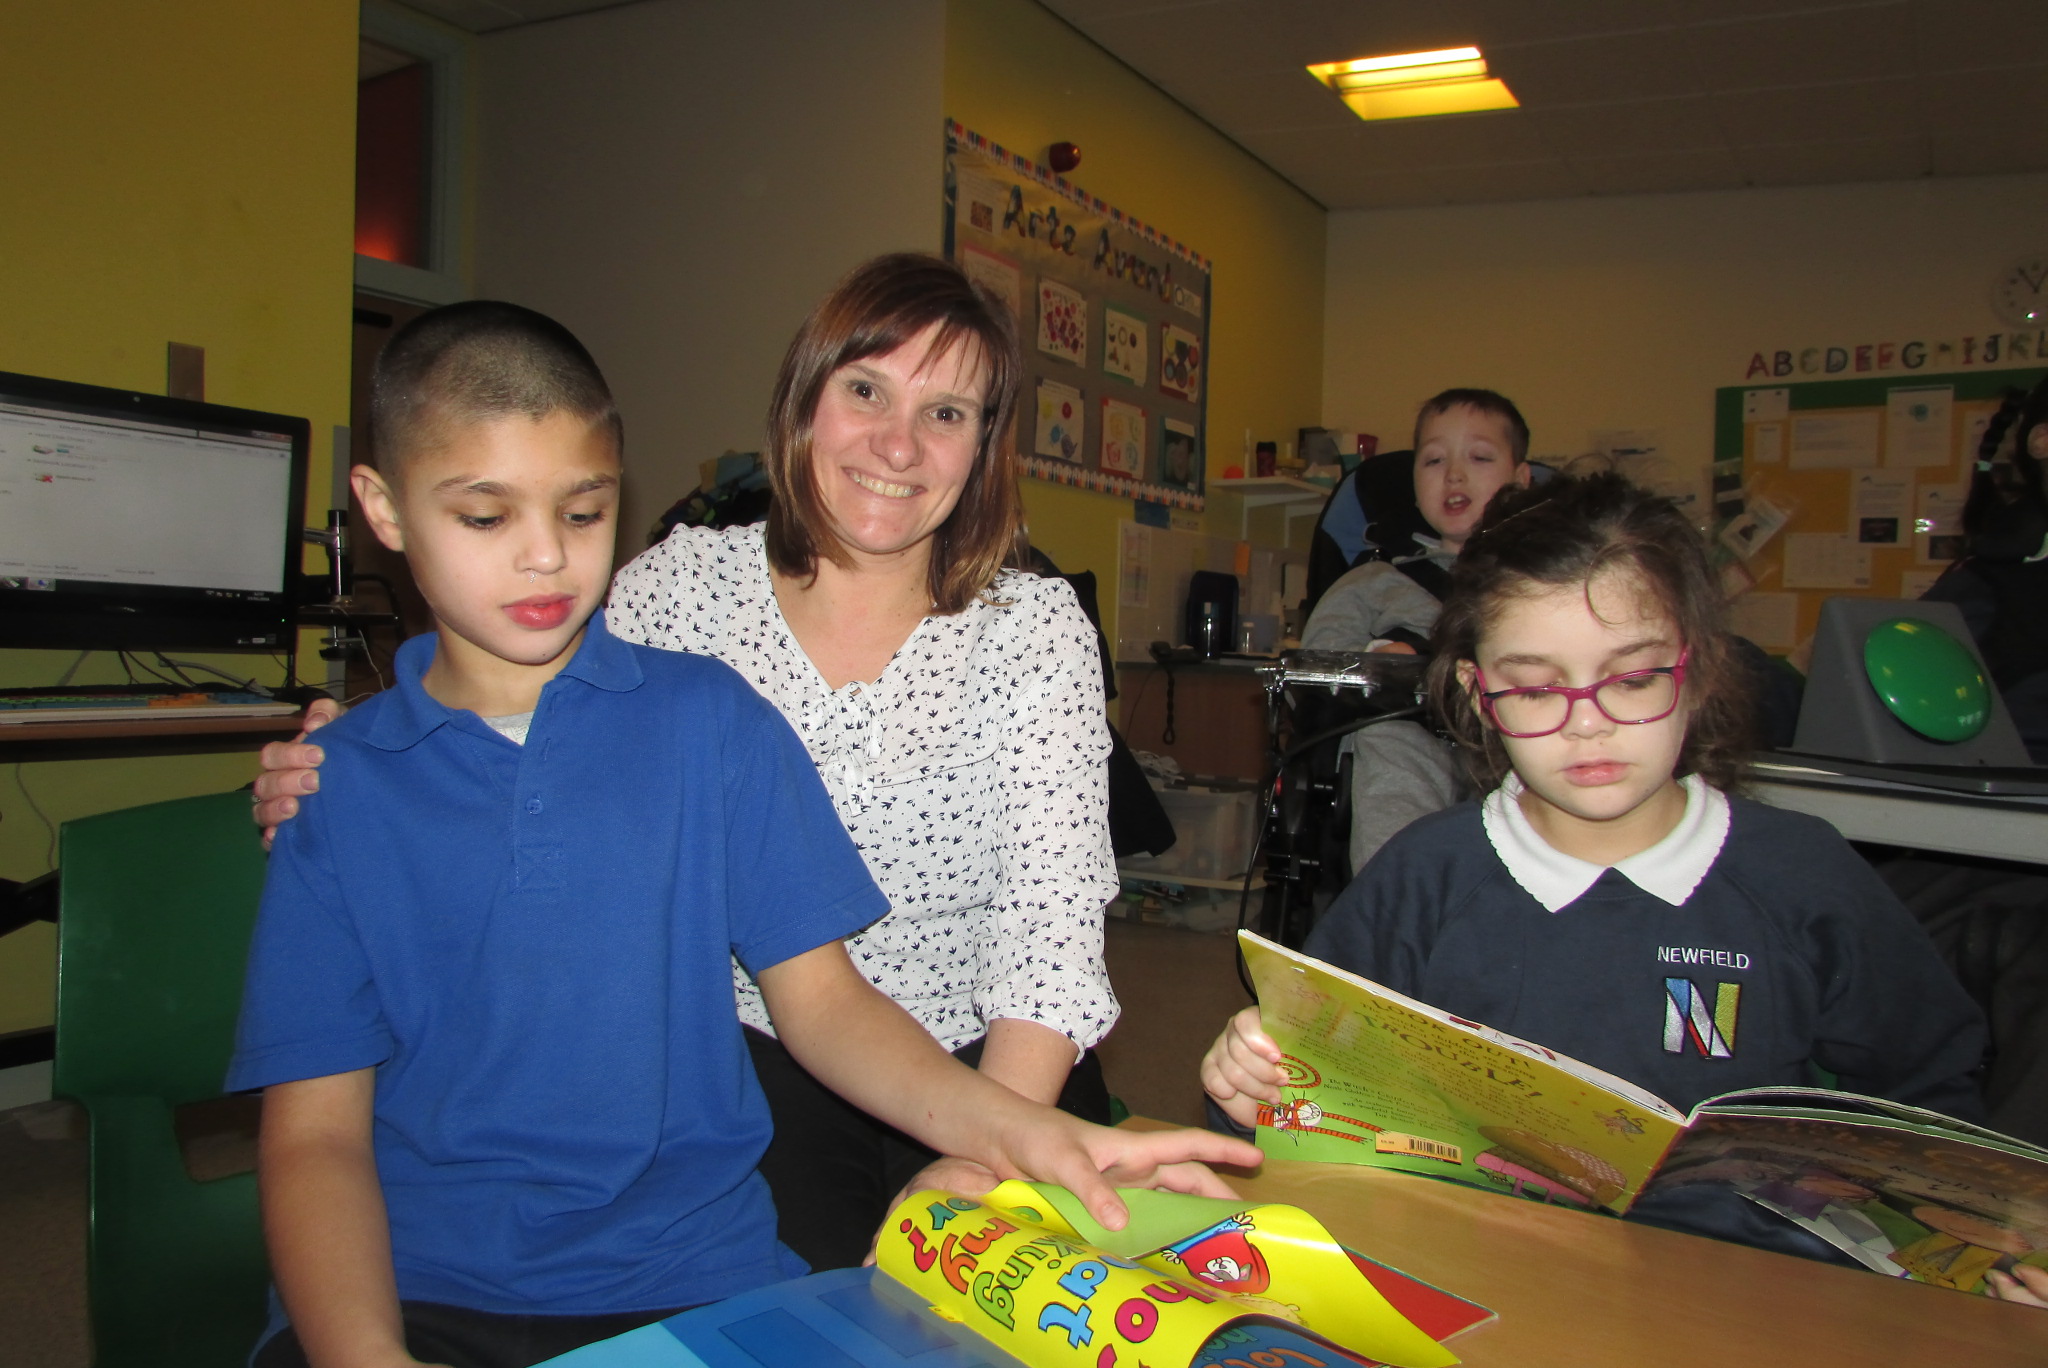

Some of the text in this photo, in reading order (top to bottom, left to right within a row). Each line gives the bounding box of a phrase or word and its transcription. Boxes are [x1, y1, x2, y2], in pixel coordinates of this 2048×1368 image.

[1003, 184, 1077, 256] Arts
[1093, 226, 1172, 303] Award
[1657, 945, 1750, 969] NEWFIELD
[1354, 1011, 1543, 1097] TROUBLE!
[1371, 999, 1448, 1033] LOOK
[1462, 1037, 1530, 1069] OUT!
